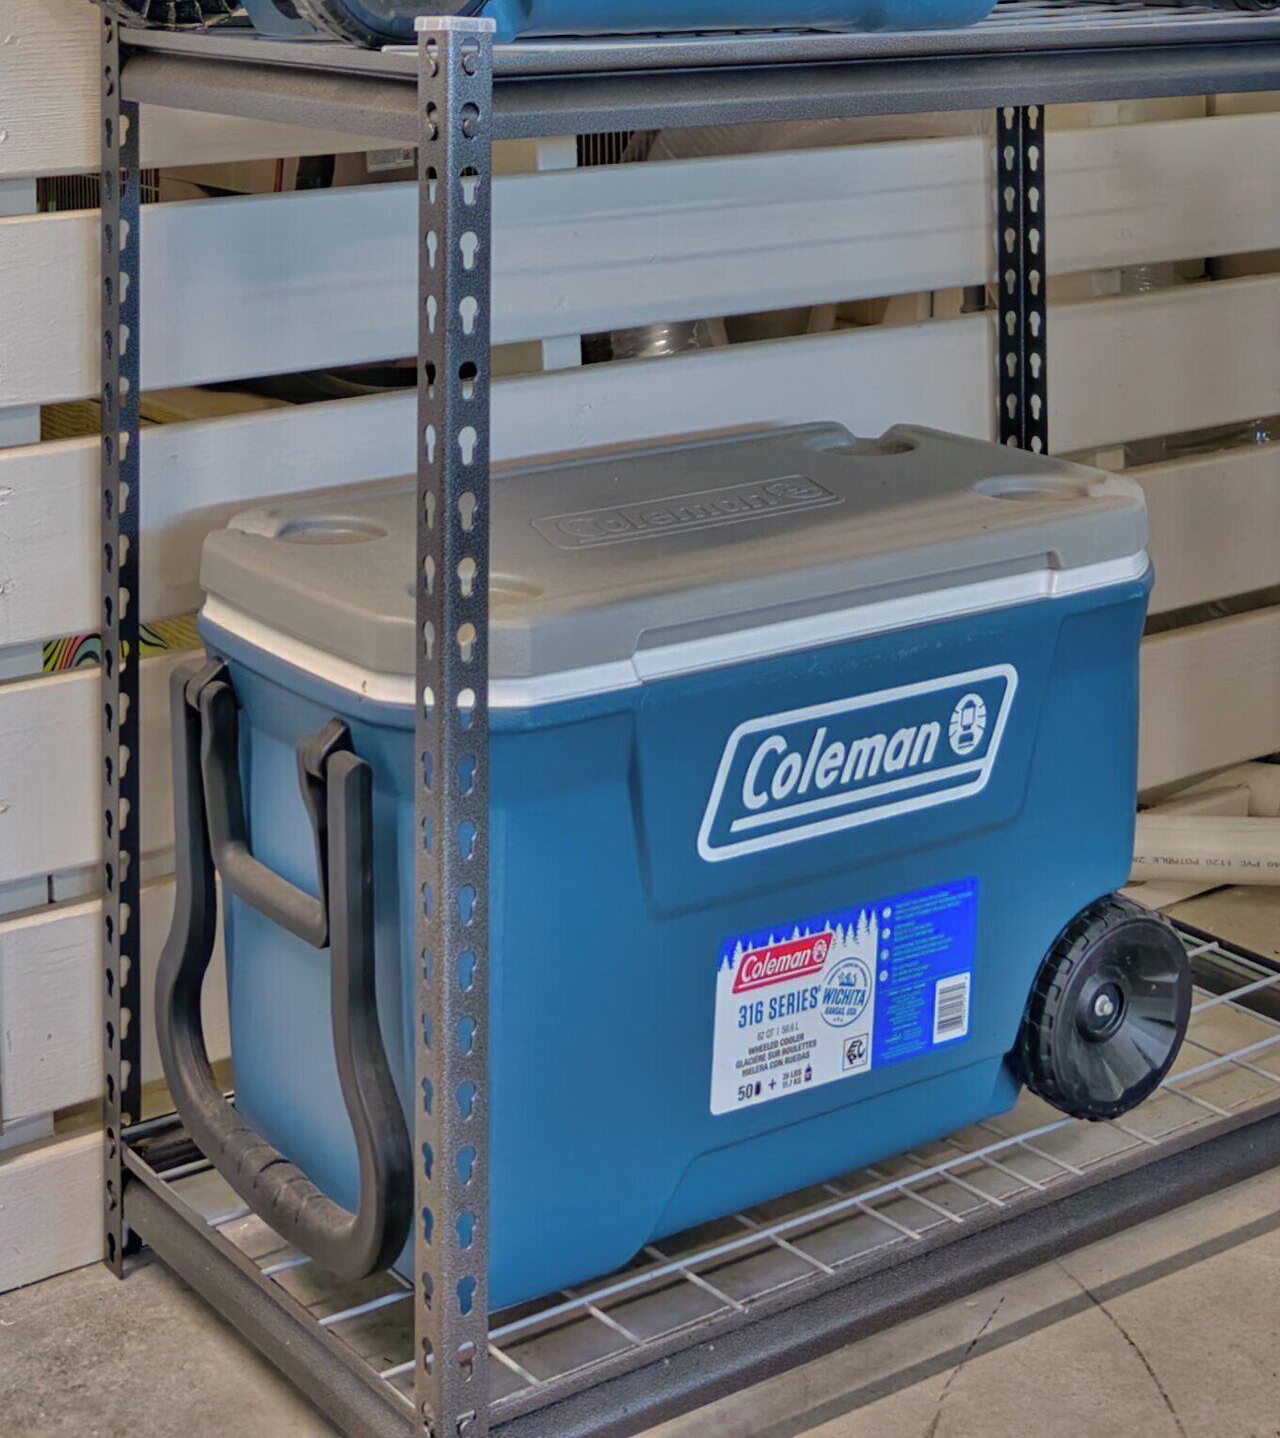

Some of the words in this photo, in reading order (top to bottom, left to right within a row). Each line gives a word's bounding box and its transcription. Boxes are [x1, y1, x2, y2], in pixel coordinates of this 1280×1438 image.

[556, 495, 778, 537] Coleman
[742, 721, 941, 810] Coleman
[1153, 856, 1199, 866] POTABLE
[1206, 859, 1232, 867] 1120
[1240, 860, 1261, 868] PVC
[741, 949, 812, 983] Coleman
[822, 986, 866, 1006] WICHITA
[738, 1001, 764, 1029] 316
[768, 986, 818, 1020] SERIES
[748, 1040, 779, 1055] WHEELED
[780, 1032, 804, 1046] COOLER
[767, 1049, 781, 1061] SUR
[781, 1039, 817, 1055] ROULETTES
[769, 1059, 784, 1070] CON
[784, 1051, 810, 1065] RUEDAS
[737, 1083, 754, 1101] 50
